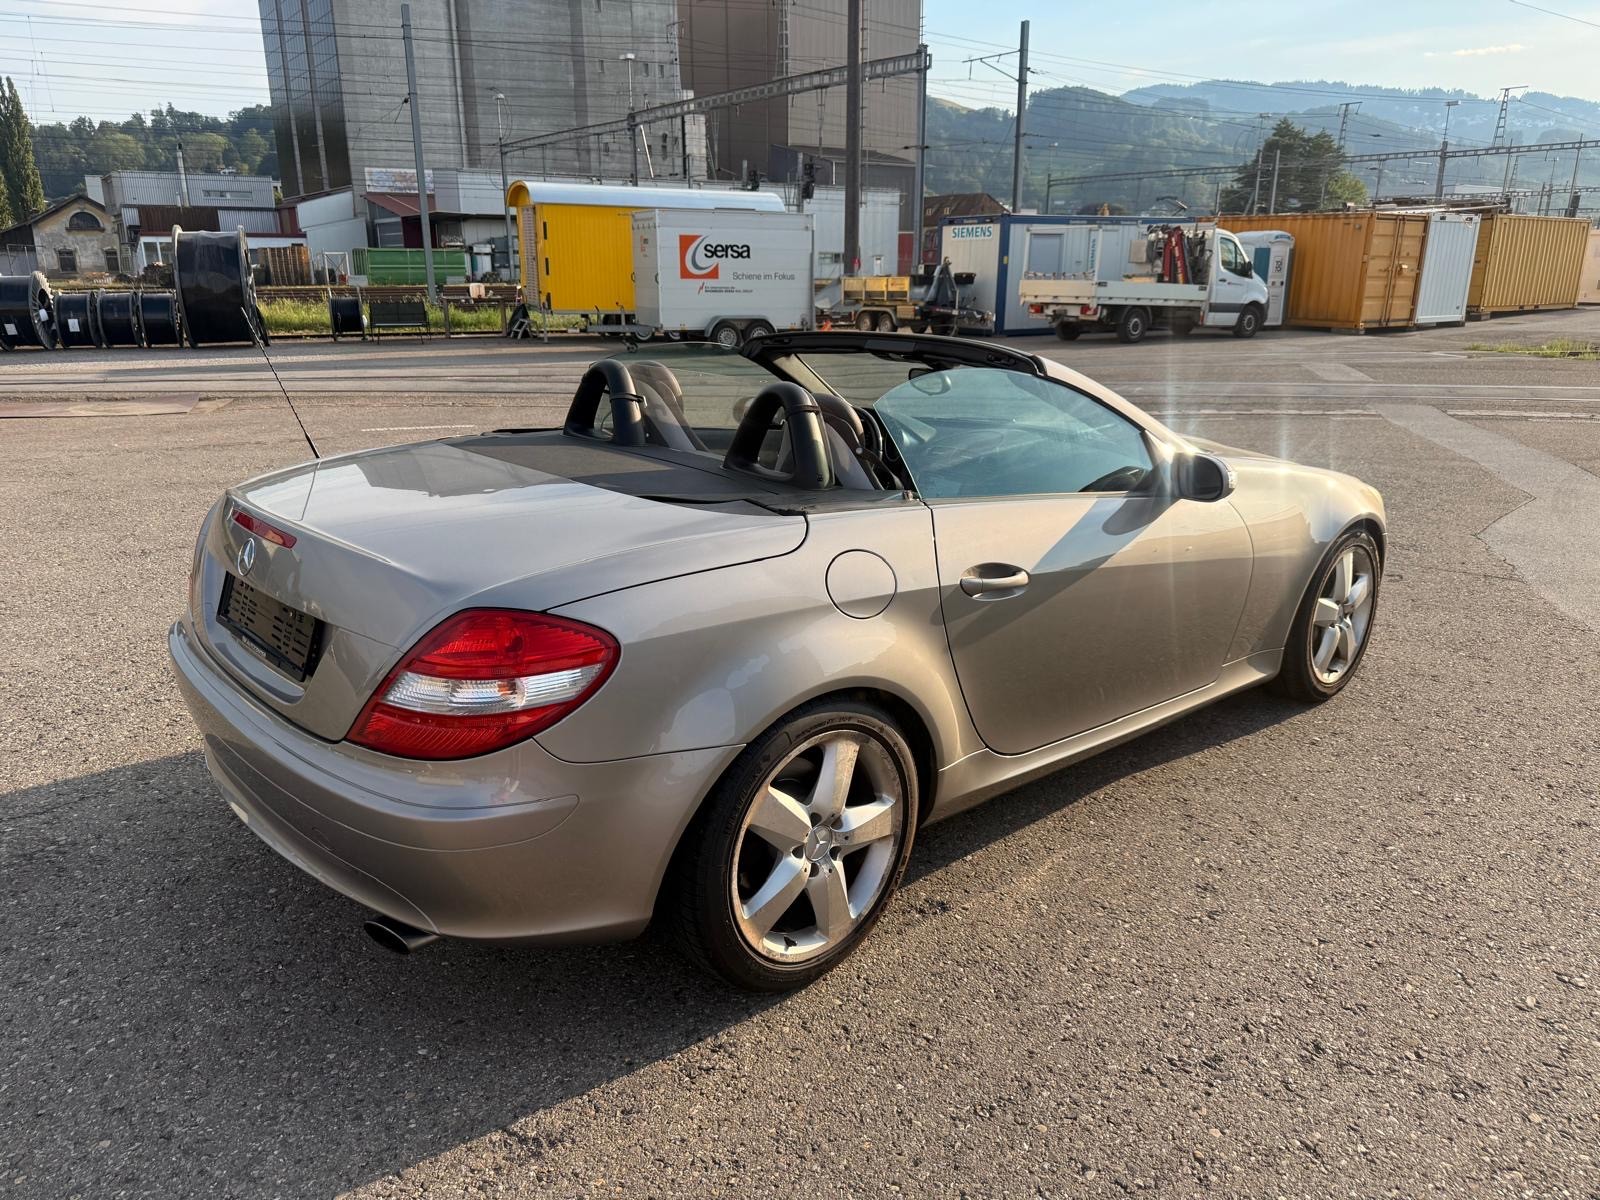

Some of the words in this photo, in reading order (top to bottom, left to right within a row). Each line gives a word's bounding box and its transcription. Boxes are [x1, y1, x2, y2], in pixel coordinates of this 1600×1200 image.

[952, 226, 992, 239] SIEMENS
[703, 243, 751, 259] sersa
[732, 271, 762, 280] Schiene
[763, 271, 772, 280] im
[774, 271, 796, 280] Fokus
